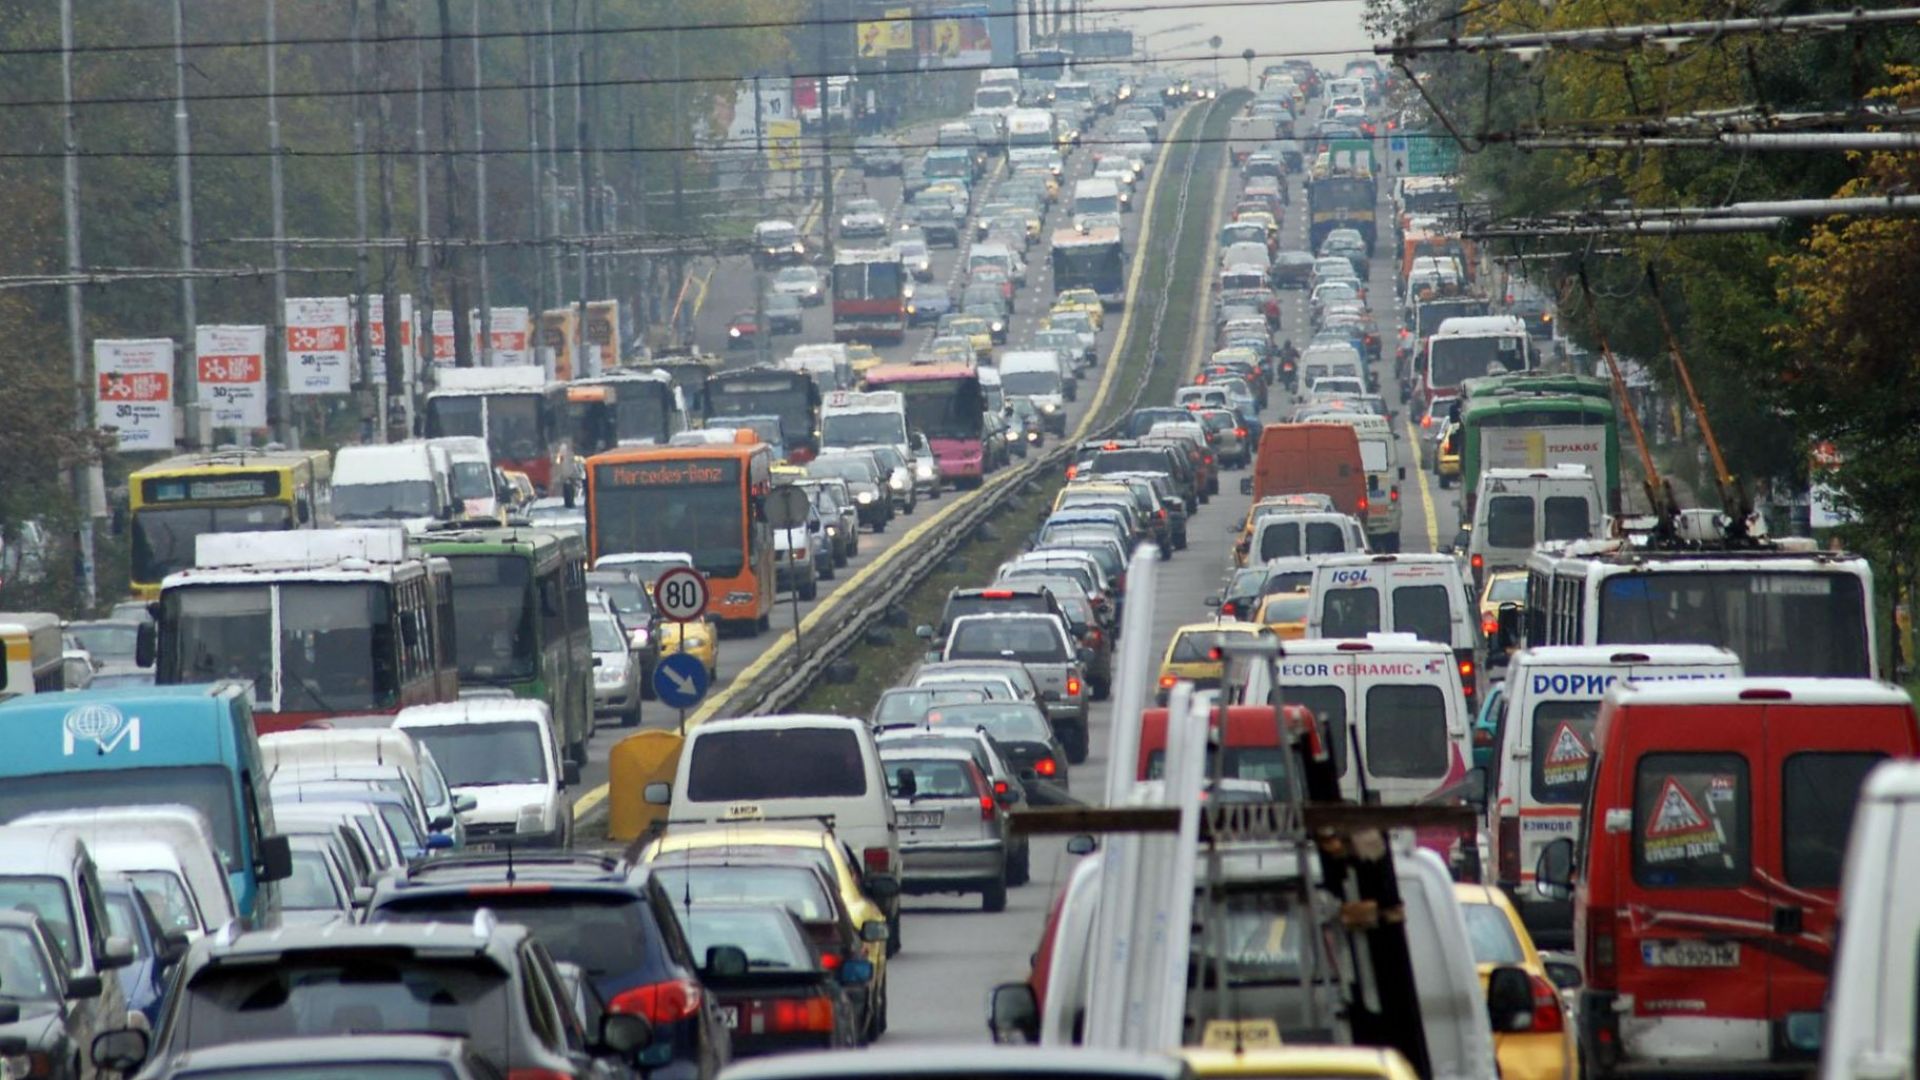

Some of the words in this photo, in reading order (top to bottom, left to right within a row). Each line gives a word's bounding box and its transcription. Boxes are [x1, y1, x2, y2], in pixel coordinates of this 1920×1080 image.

[613, 463, 723, 486] Mercedes-Benz
[666, 580, 697, 609] 80
[1276, 664, 1329, 677] ECOR
